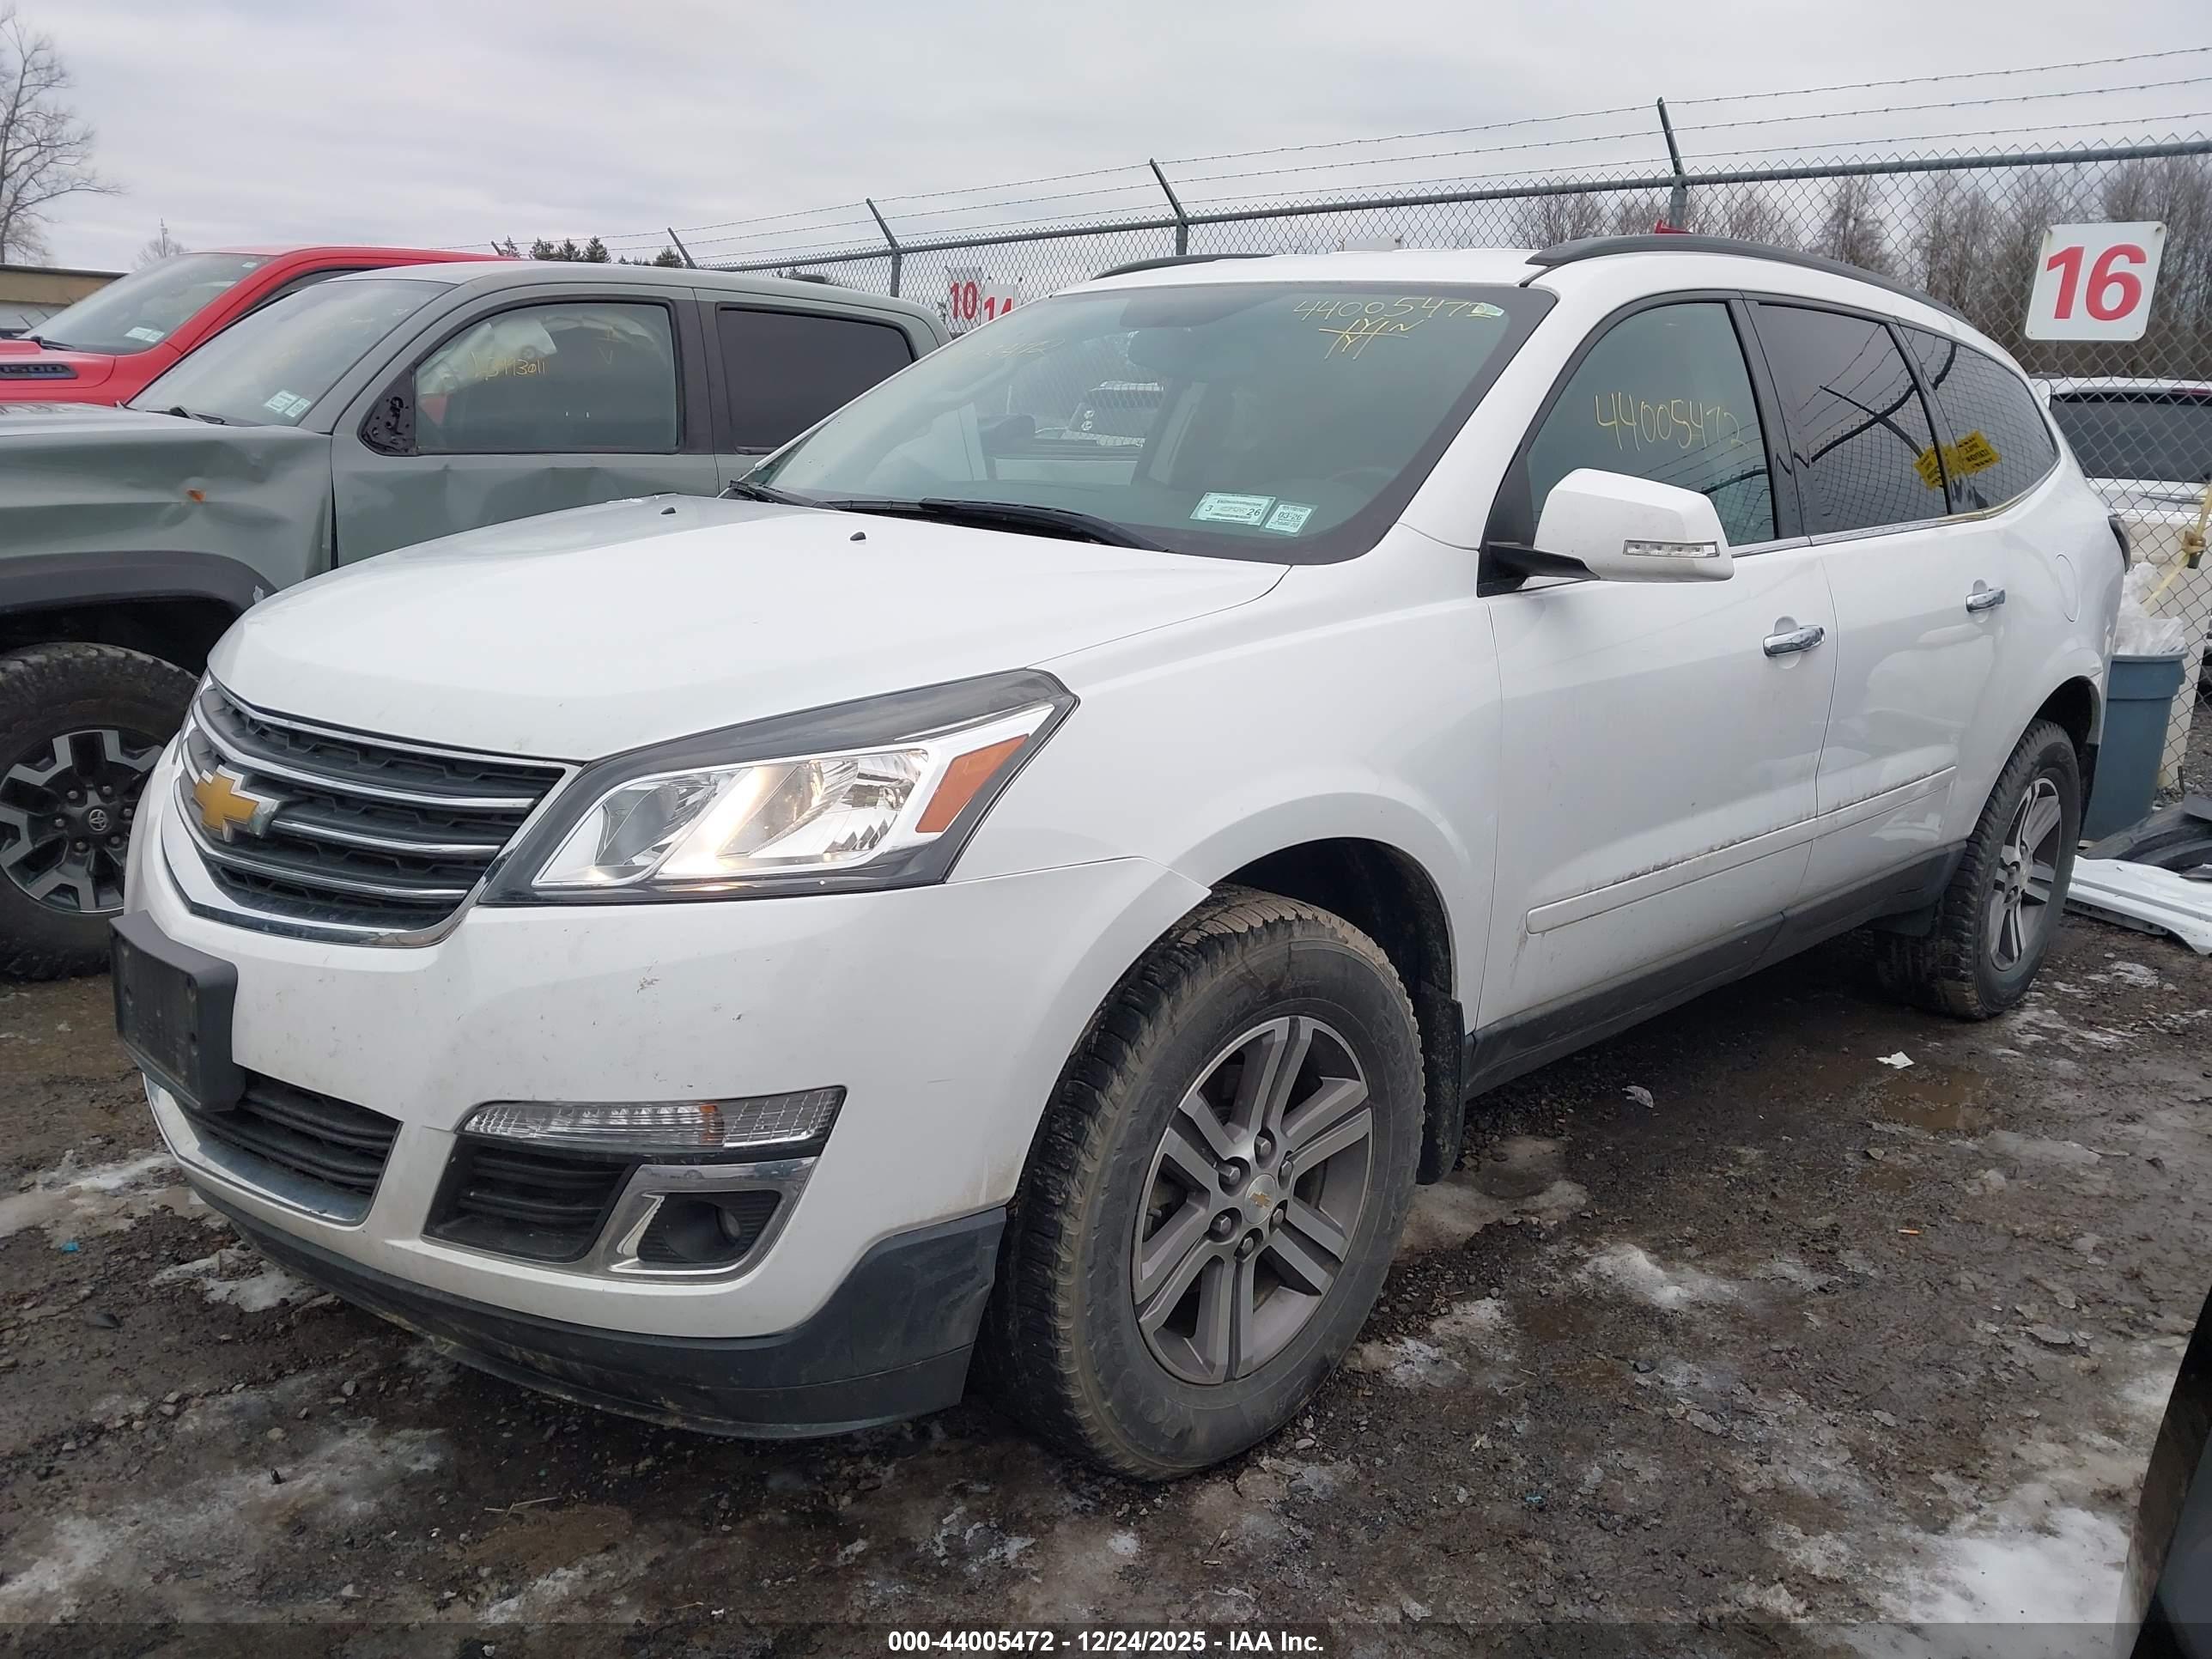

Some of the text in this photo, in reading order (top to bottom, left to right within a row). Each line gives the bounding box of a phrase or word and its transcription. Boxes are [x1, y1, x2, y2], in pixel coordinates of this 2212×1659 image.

[950, 281, 977, 320] 10
[2046, 243, 2147, 321] 16
[1595, 392, 1751, 453] 44005472
[1205, 504, 1214, 513] 3
[1246, 507, 1262, 517] 26
[1278, 511, 1304, 521] 03-26
